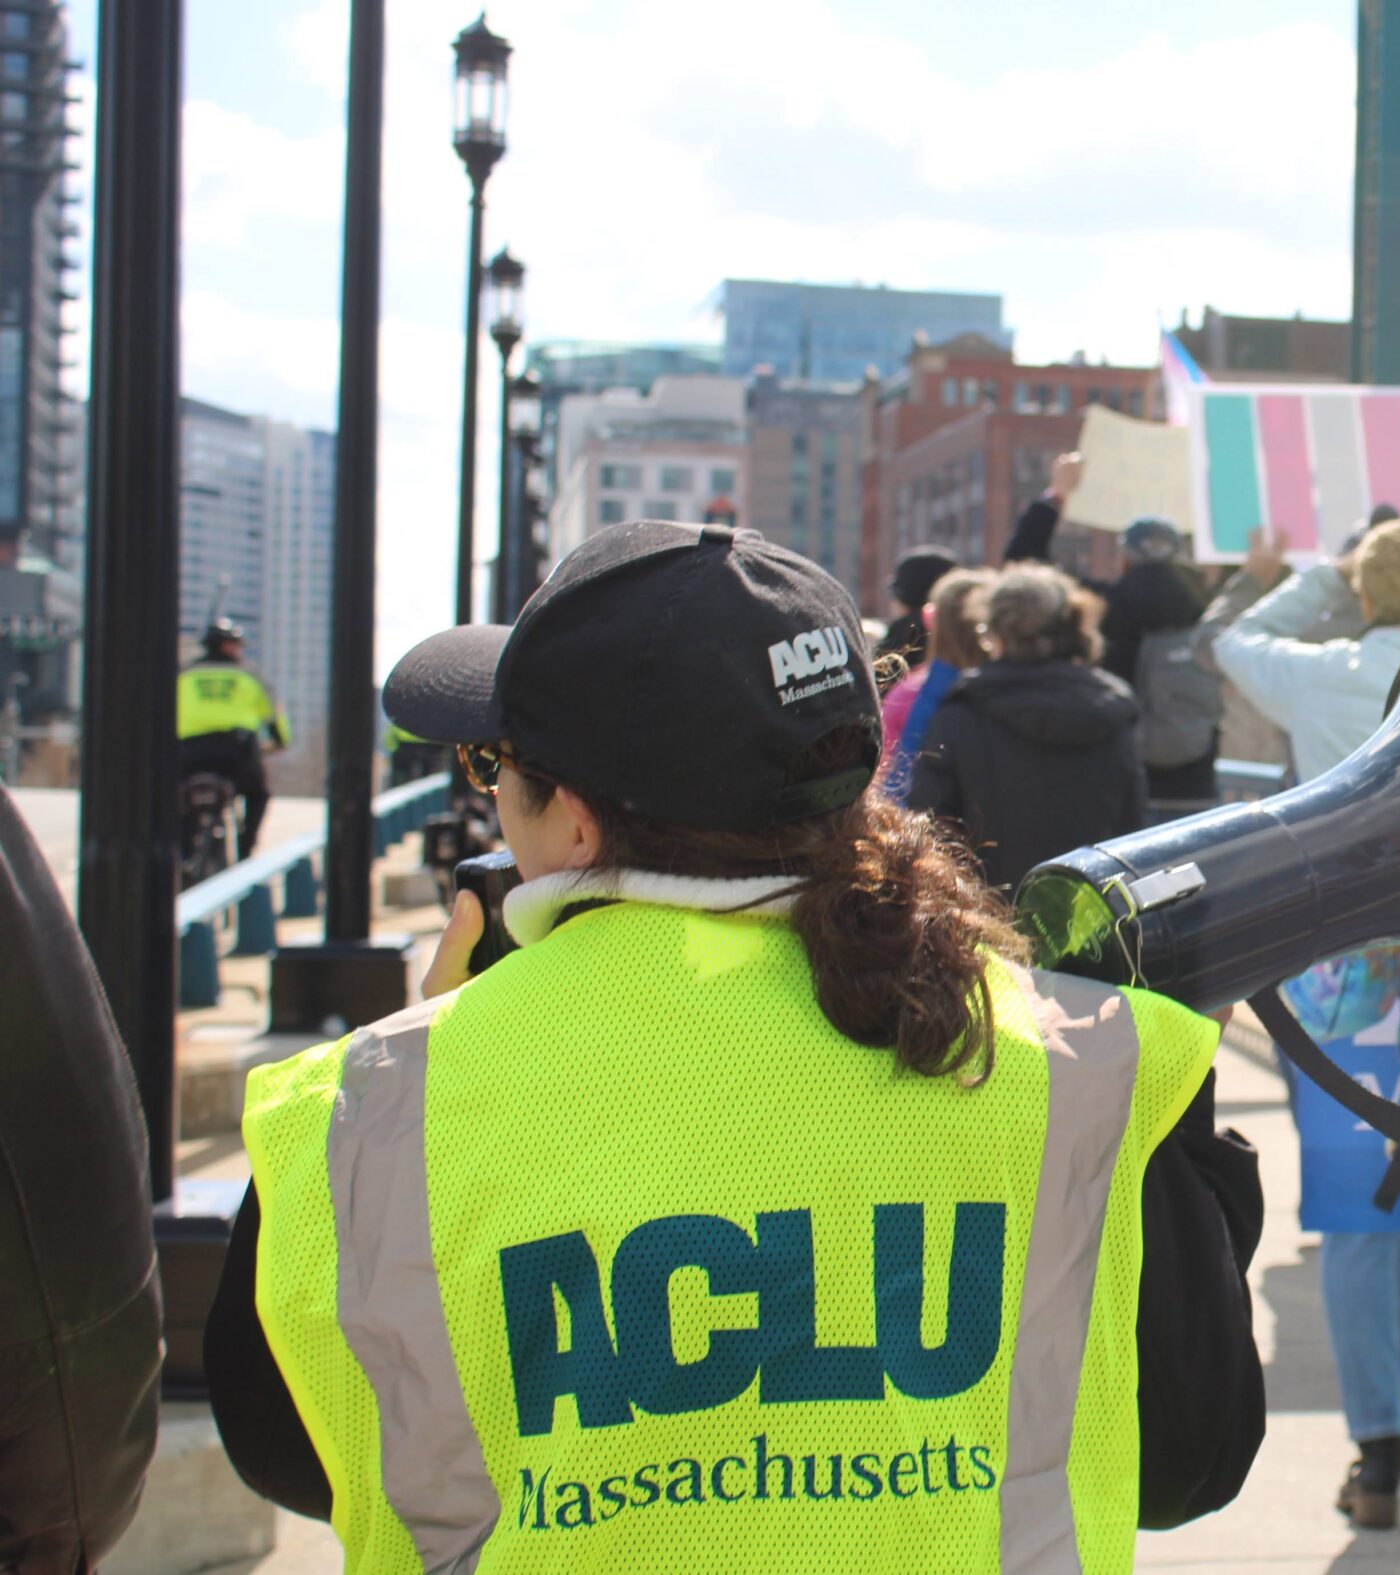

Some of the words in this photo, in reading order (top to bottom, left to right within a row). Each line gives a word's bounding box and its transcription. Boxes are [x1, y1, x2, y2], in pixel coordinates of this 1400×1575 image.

[768, 626, 849, 688] ACLU
[499, 1202, 1006, 1437] ACLU
[519, 1432, 997, 1531] Massachusetts
